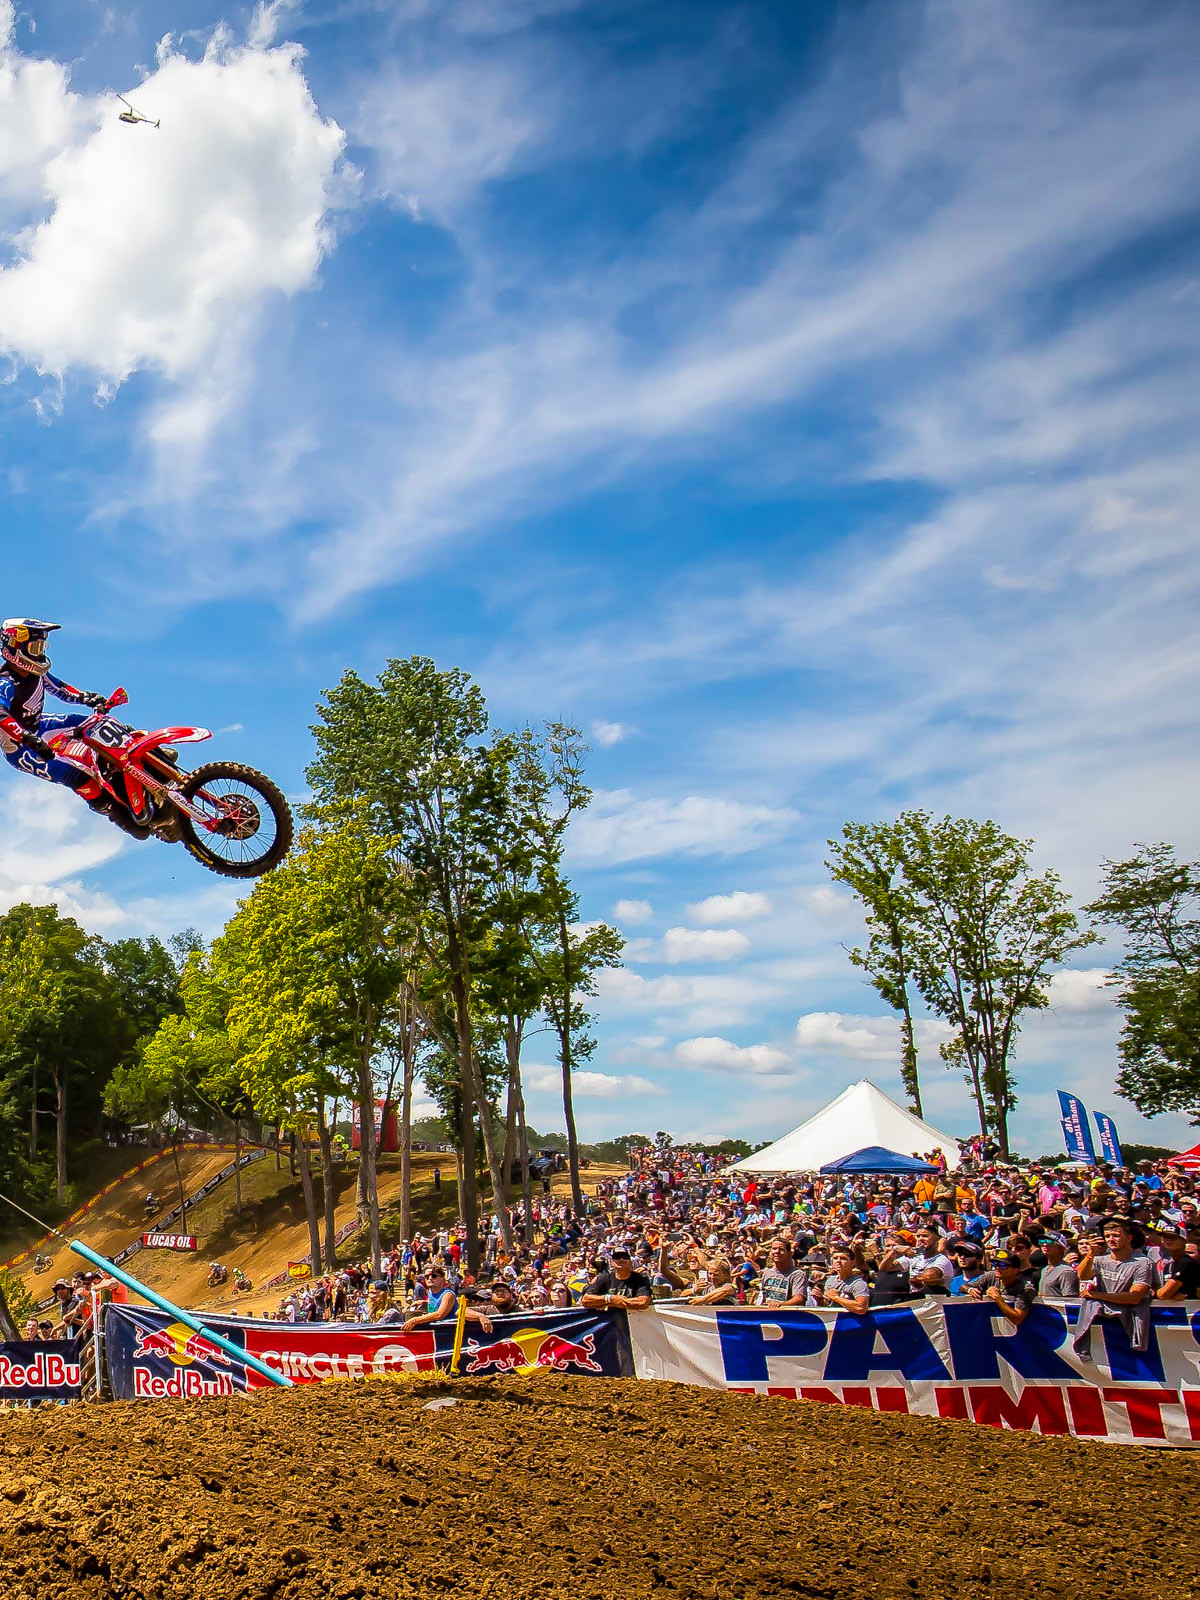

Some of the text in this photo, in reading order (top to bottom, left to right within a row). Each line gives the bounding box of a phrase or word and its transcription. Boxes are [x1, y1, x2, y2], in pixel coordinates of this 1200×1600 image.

[1064, 1116, 1075, 1133] VIP
[1068, 1099, 1079, 1124] SUPER
[146, 1234, 176, 1248] LUCAS
[176, 1236, 192, 1248] OIL
[715, 1306, 1200, 1383] PART
[259, 1350, 365, 1379] CIRCLE
[134, 1367, 234, 1397] Red Bull
